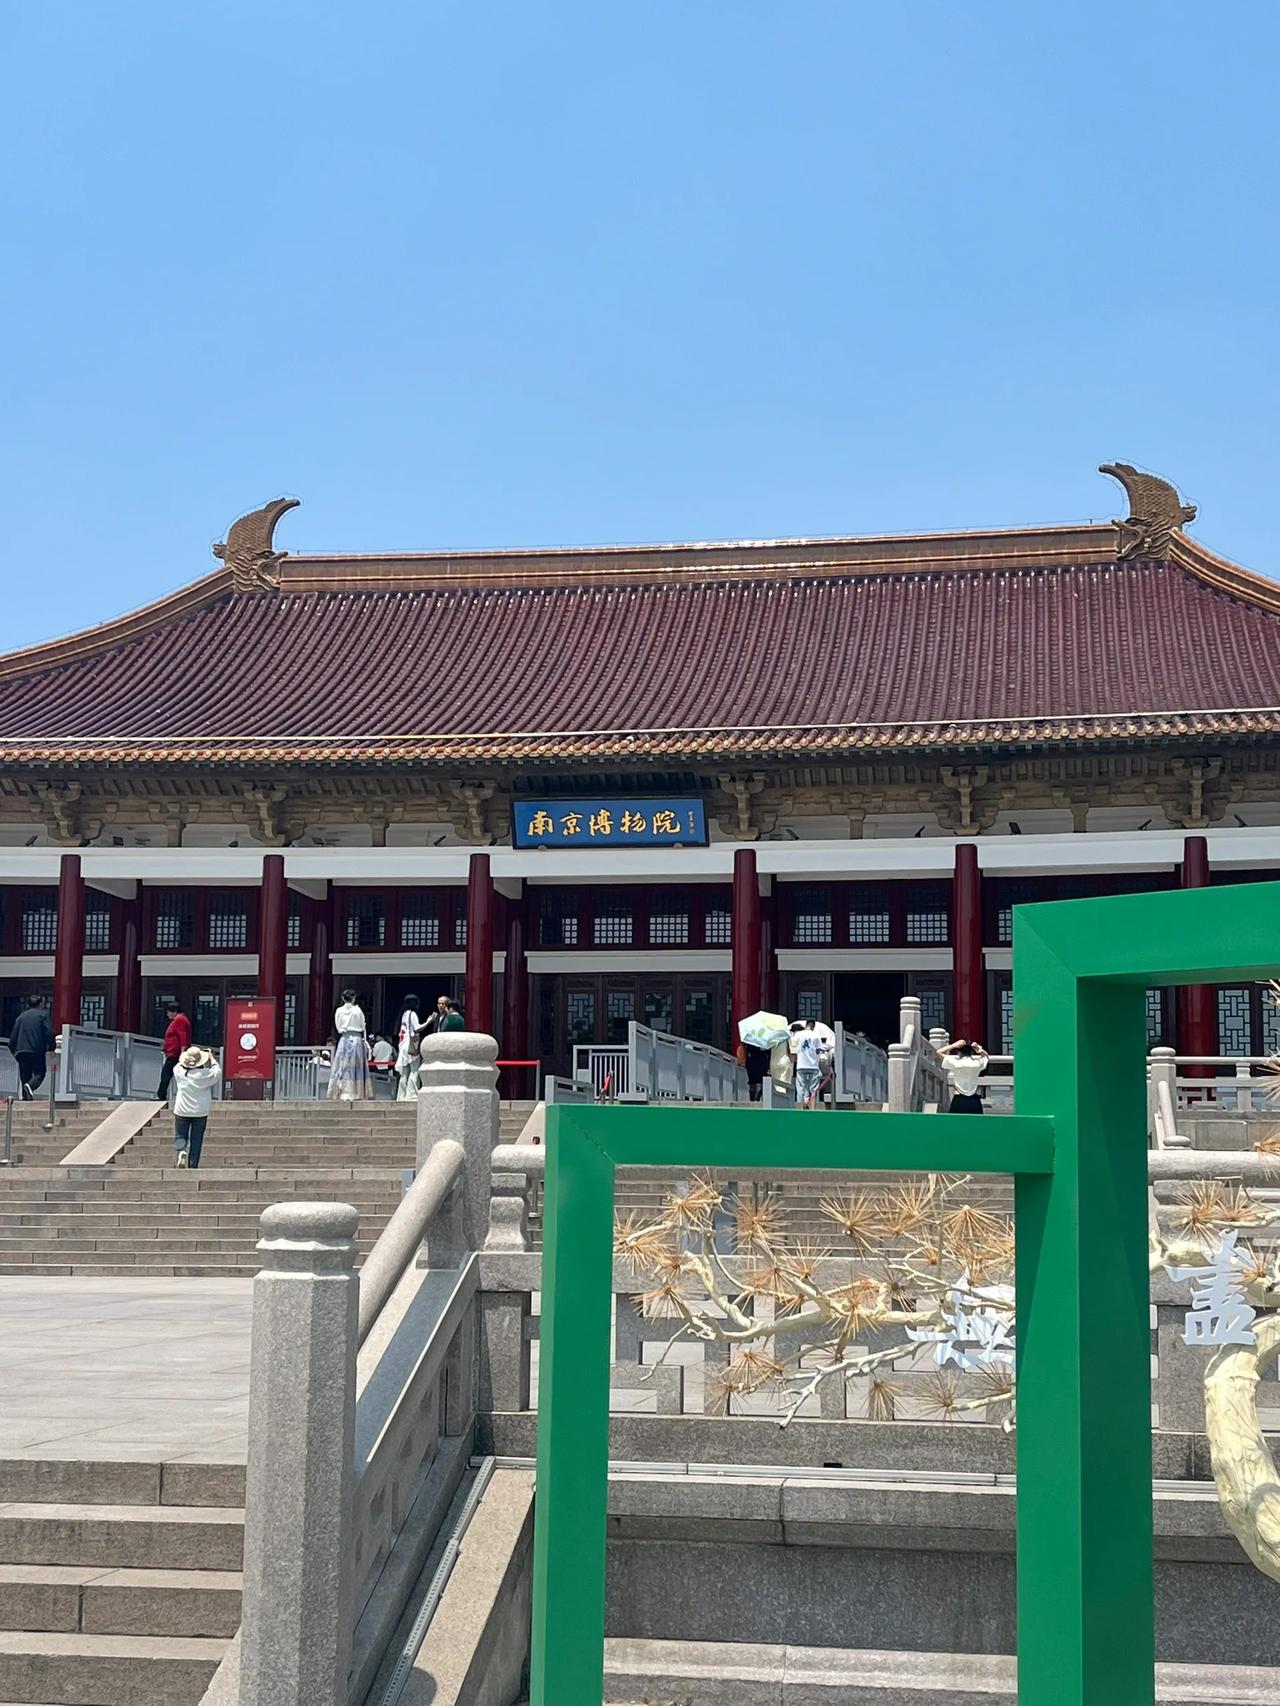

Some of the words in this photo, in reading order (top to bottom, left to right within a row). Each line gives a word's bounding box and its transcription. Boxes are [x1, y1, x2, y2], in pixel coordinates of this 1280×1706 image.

[528, 808, 681, 836] 南京博物院
